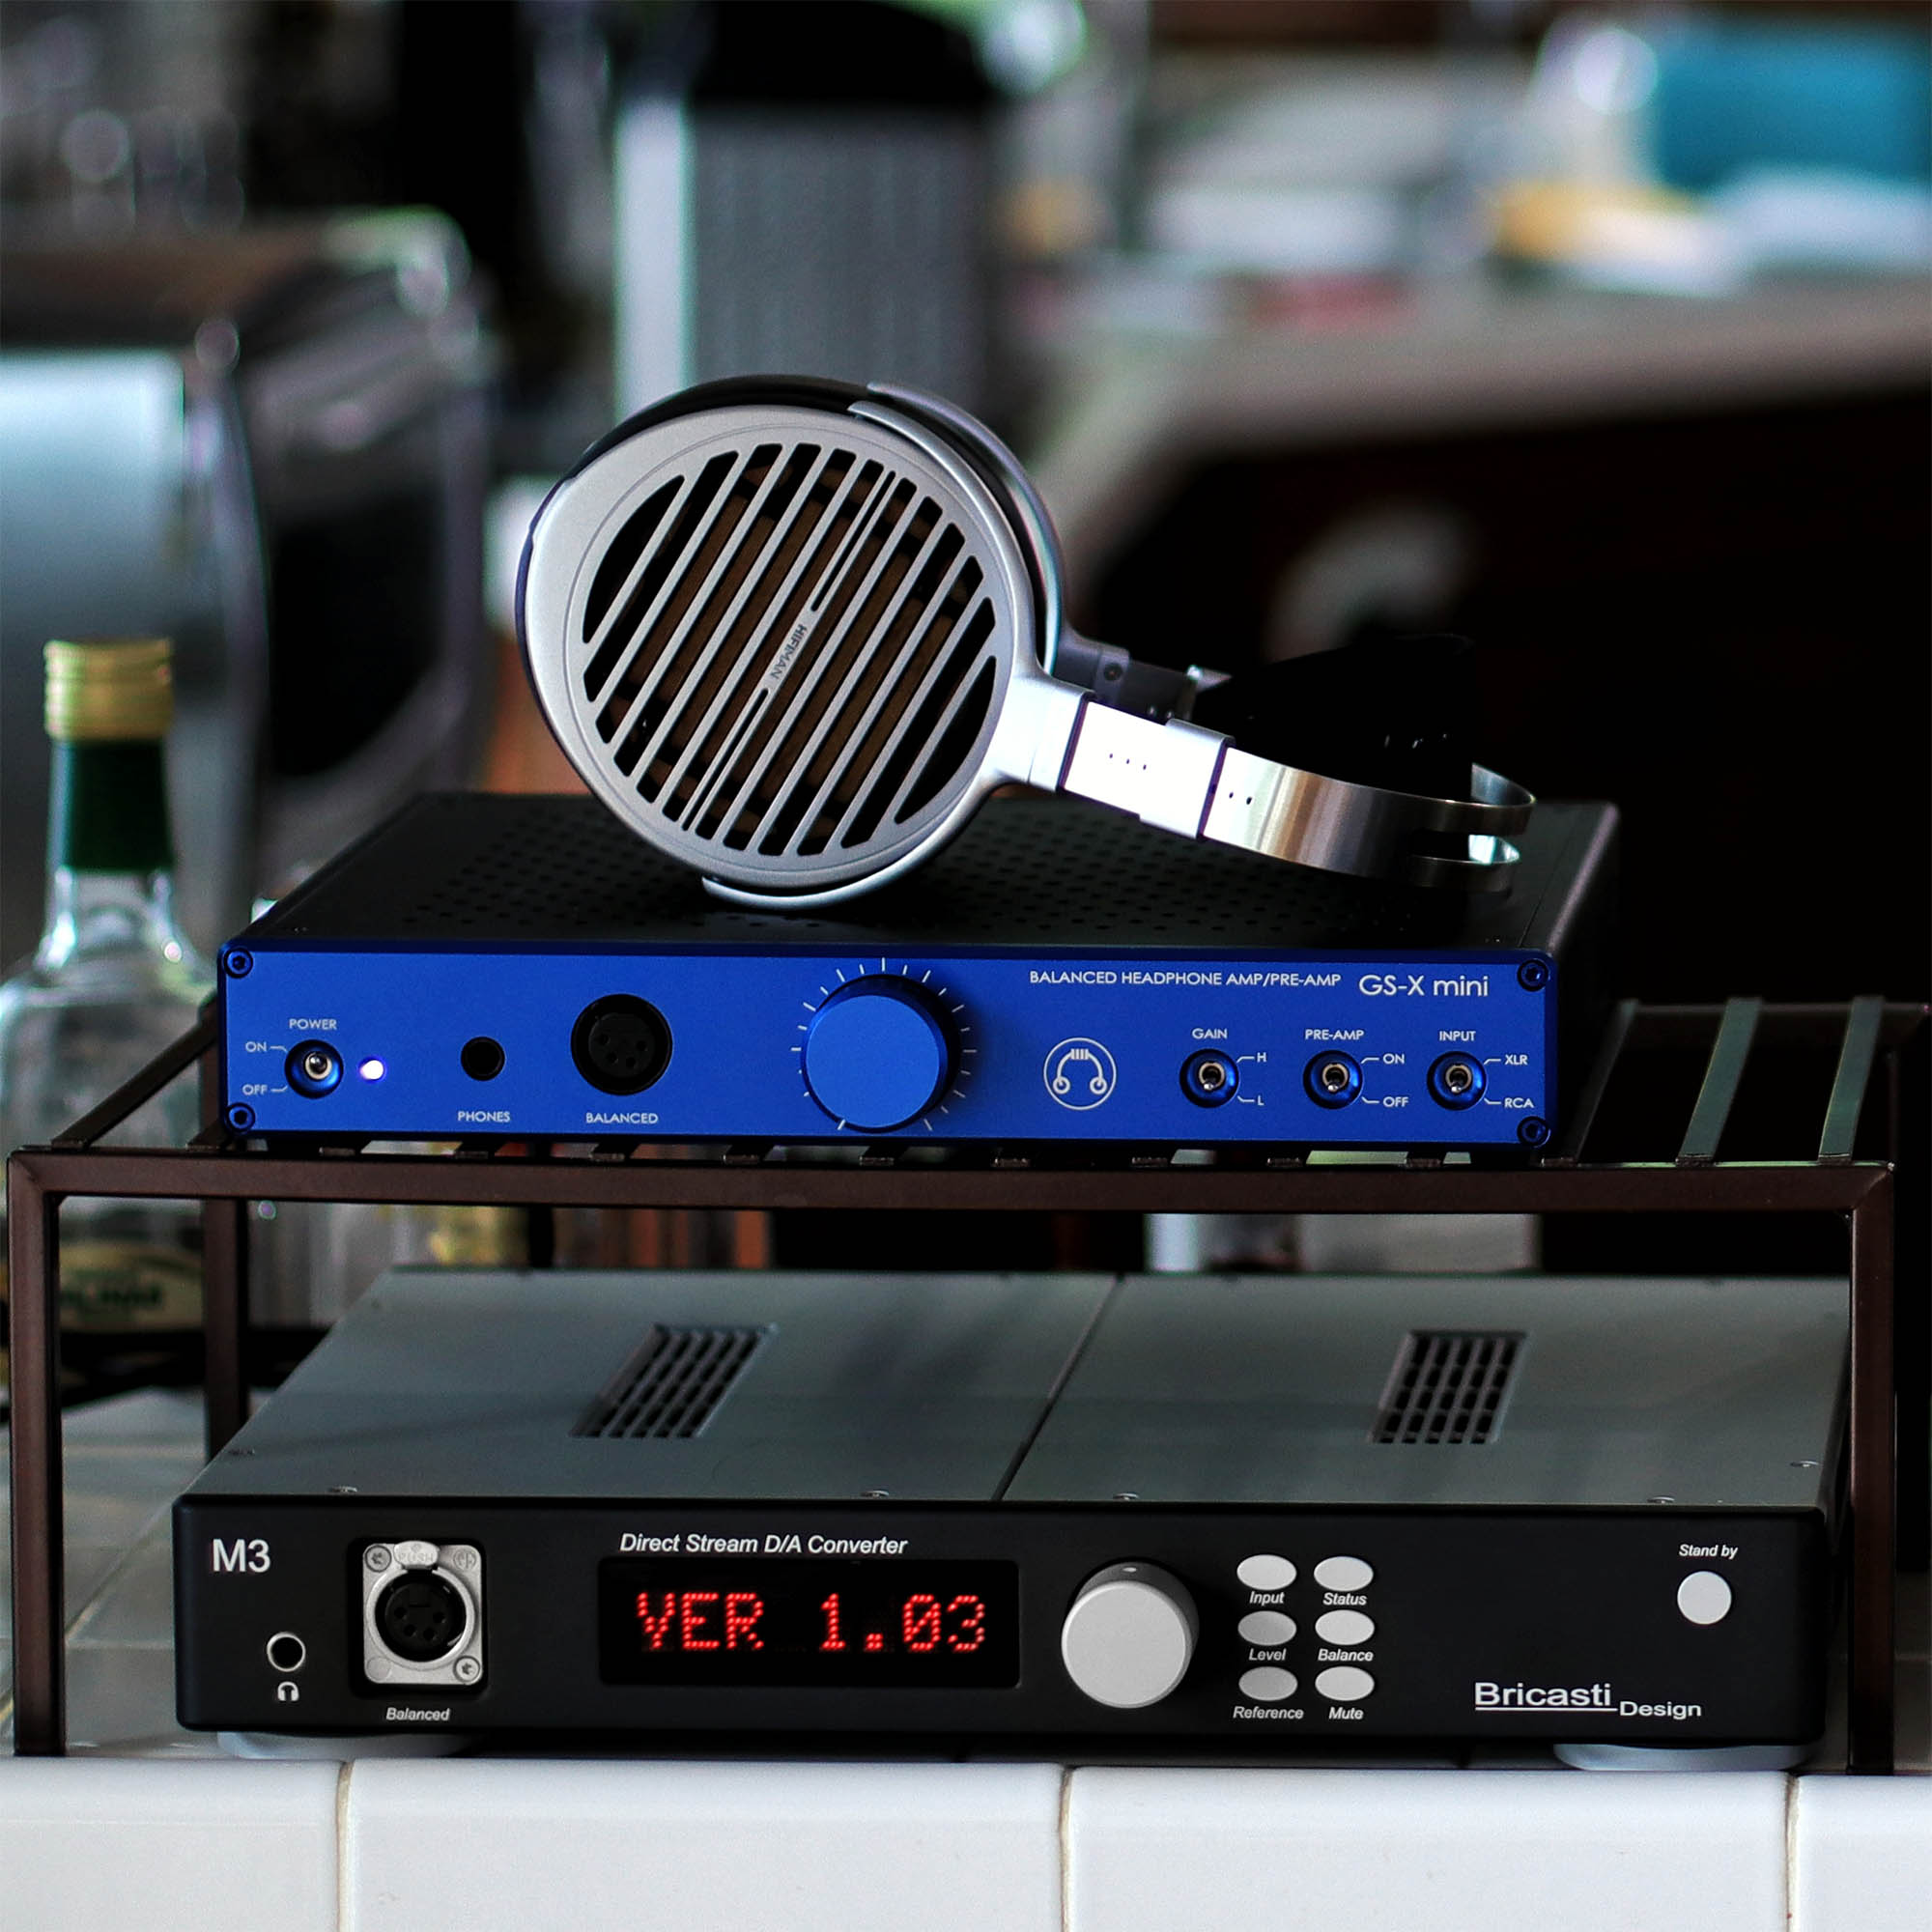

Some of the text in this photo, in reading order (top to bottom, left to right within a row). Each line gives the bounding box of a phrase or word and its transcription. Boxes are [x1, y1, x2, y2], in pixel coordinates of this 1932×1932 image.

[769, 623, 809, 680] HIFIMAN
[1030, 970, 1342, 987] BALANCED HEADPHONE AMP/PRE-AMP
[1358, 974, 1489, 997] GS-X mini
[289, 1018, 337, 1031] POWER
[1191, 1027, 1228, 1039] GAIN
[1305, 1029, 1365, 1040] PRE-AMP
[1438, 1030, 1477, 1042] INPUT
[244, 1040, 268, 1053] ON
[1257, 1051, 1267, 1063] H
[1382, 1053, 1406, 1065] ON
[1504, 1054, 1528, 1065] XLR
[242, 1083, 268, 1096] OFF
[1257, 1094, 1264, 1106] L
[1382, 1095, 1409, 1108] OFF
[1504, 1096, 1535, 1109] RCA
[457, 1110, 511, 1123] PHONES
[585, 1112, 659, 1124] BALANCED
[619, 1533, 909, 1555] Direct Stream D/A Converter
[213, 1539, 270, 1573] M3
[1678, 1544, 1739, 1560] Stand by
[1249, 1591, 1285, 1606] Input
[1322, 1592, 1367, 1605] Status
[637, 1592, 985, 1652] VER 1.03
[1248, 1648, 1287, 1662] Level
[1318, 1648, 1374, 1662] Balance
[1474, 1682, 1611, 1707] Bricasti
[385, 1707, 451, 1721] Balanced
[1233, 1705, 1304, 1719] Reference
[1328, 1706, 1364, 1720] Mute
[1619, 1700, 1702, 1720] Design
